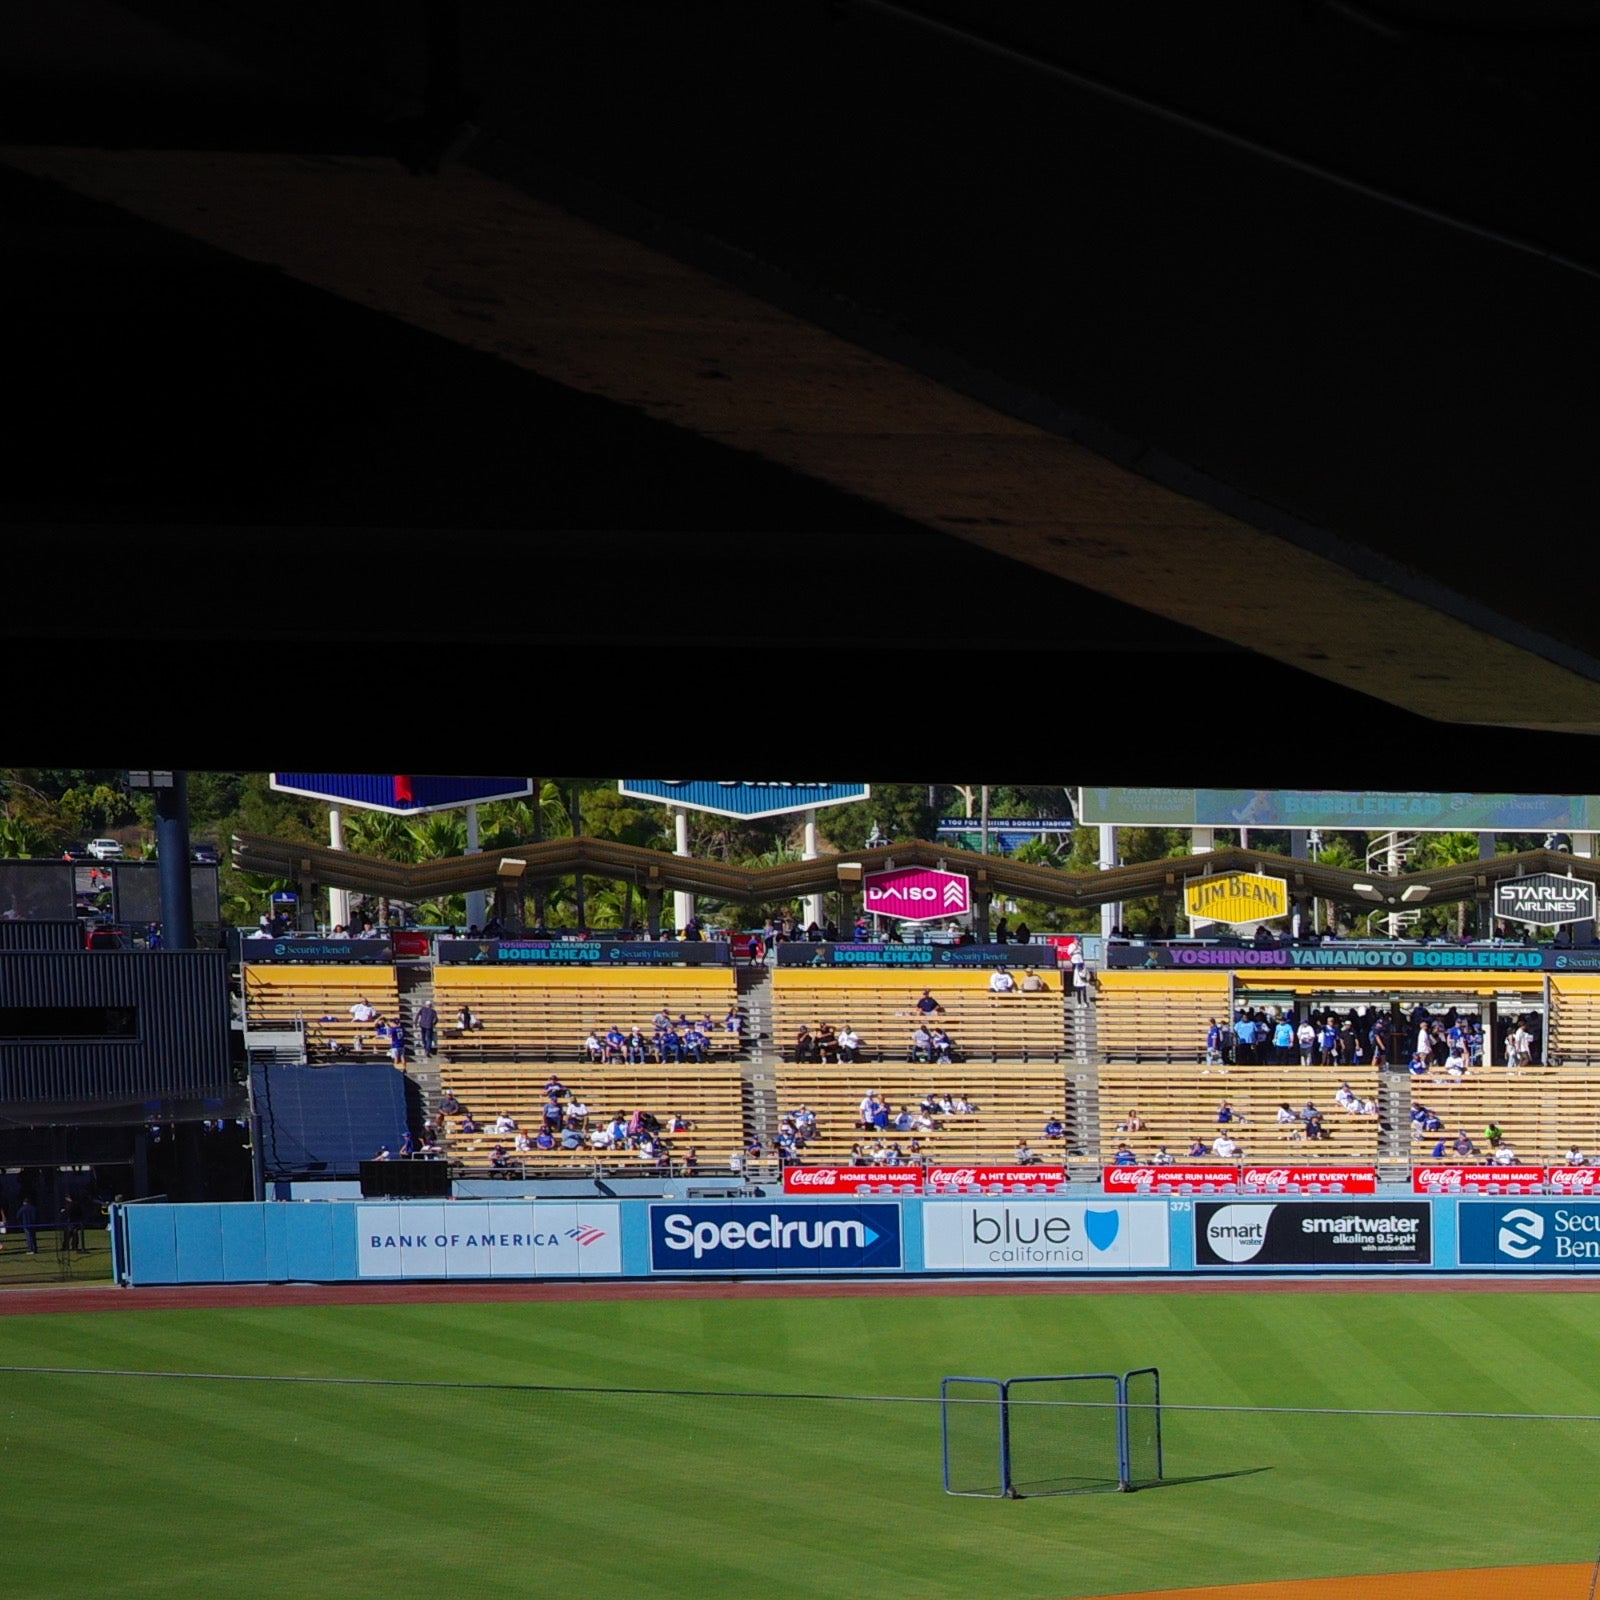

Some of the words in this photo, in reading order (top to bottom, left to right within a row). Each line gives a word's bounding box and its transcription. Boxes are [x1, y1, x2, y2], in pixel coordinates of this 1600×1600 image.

[1285, 797, 1443, 816] BOBBLEHEAD
[869, 886, 938, 901] DAISO
[1192, 884, 1225, 912] JIM
[1229, 876, 1278, 908] BEAM
[1500, 886, 1589, 901] STARLUX
[1514, 902, 1577, 912] AIRLINES
[287, 944, 320, 956] Security
[322, 944, 351, 955] Benefit
[499, 948, 600, 960] BOBBLEHEAD
[834, 951, 932, 963] BOBBLEHEAD
[1169, 950, 1287, 965] YOSHINOBU
[1290, 951, 1406, 966] YAMAMOTO
[1413, 951, 1543, 967] BOBBLEHEAD
[790, 1169, 838, 1185] Coca-Cola
[840, 1173, 867, 1181] HOME
[868, 1173, 887, 1181] RUN
[888, 1173, 917, 1181] MAGIC
[930, 1169, 977, 1184] Coca-Cola
[1110, 1169, 1155, 1185] Coca-Cola
[1158, 1173, 1183, 1181] HOME
[1185, 1173, 1203, 1181] RUN
[1205, 1173, 1233, 1181] MAGIC
[1245, 1169, 1290, 1185] Coca-Cola
[1293, 1173, 1300, 1181] A
[1301, 1173, 1317, 1181] HIT
[1319, 1173, 1349, 1181] EVERY
[1350, 1173, 1373, 1181] TIME
[1418, 1169, 1464, 1184] Coca-Cola
[1465, 1173, 1490, 1181] HOME
[1491, 1173, 1510, 1181] RUN
[1511, 1173, 1538, 1181] MAGIC
[1551, 1169, 1597, 1184] Coca-Cola
[1170, 1202, 1191, 1212] 375
[973, 1208, 1071, 1244] blue
[1210, 1223, 1263, 1239] smart
[1301, 1215, 1420, 1234] smartwater
[371, 1235, 428, 1248] BANK
[434, 1235, 460, 1248] OF
[466, 1233, 560, 1247] AMERICA
[664, 1213, 865, 1259] Spectrum
[1239, 1238, 1263, 1246] water
[1332, 1233, 1375, 1244] alkaline
[1376, 1233, 1416, 1245] 9.5+pH
[989, 1246, 1084, 1262] california
